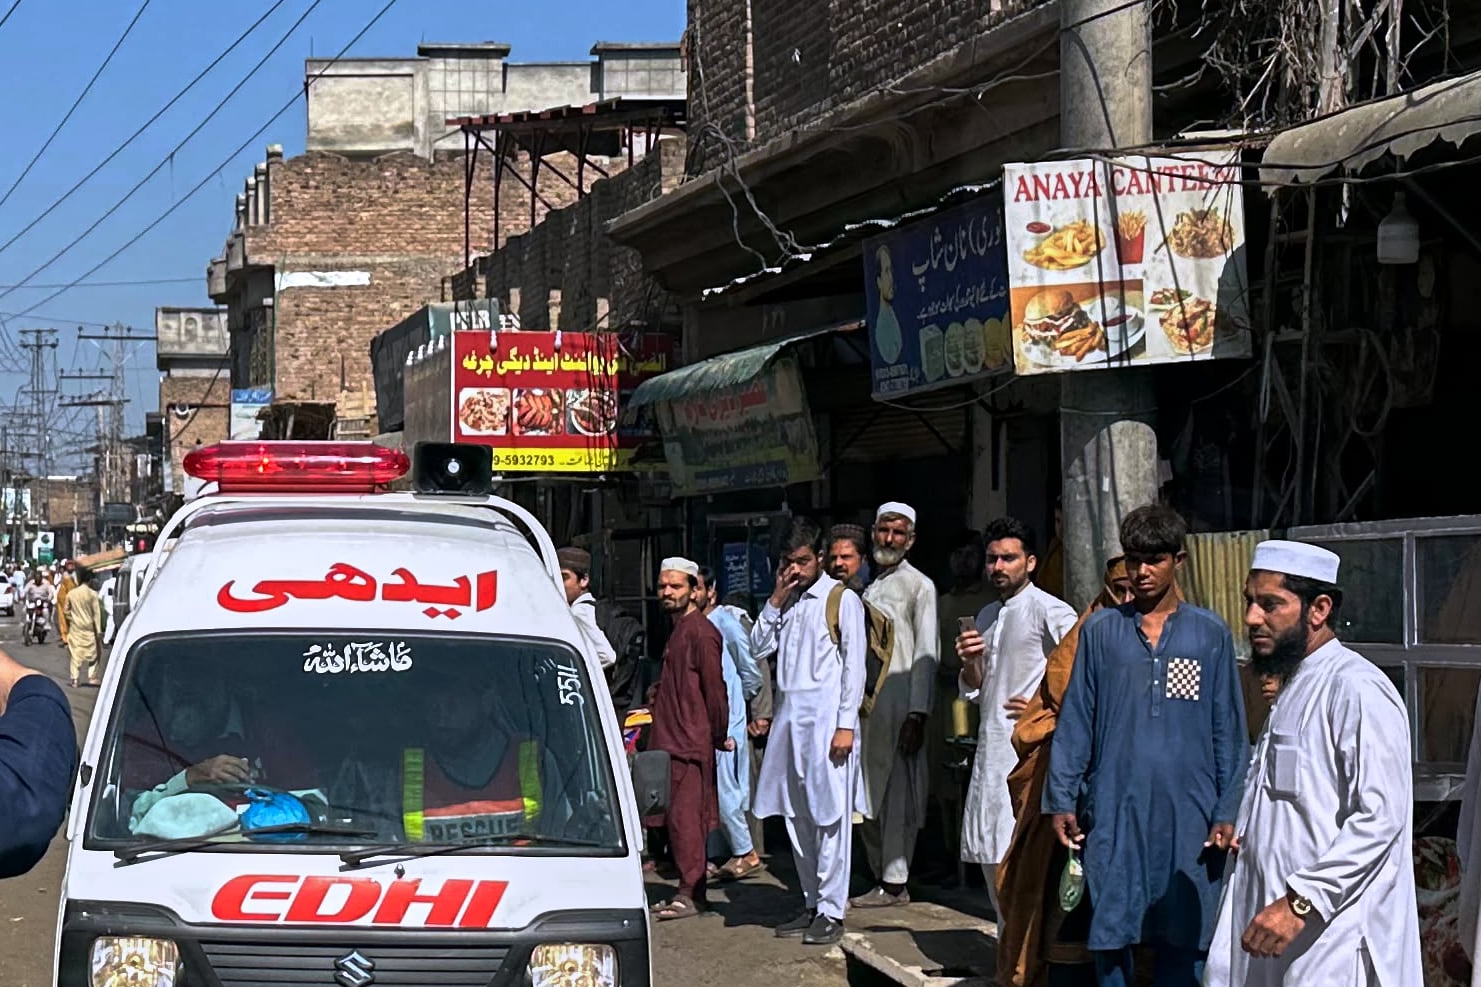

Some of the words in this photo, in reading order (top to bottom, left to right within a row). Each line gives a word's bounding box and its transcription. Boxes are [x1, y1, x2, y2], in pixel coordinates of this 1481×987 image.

[1014, 169, 1102, 203] ANAYA
[217, 562, 498, 620] ایدھی
[211, 874, 509, 928] EDHI
